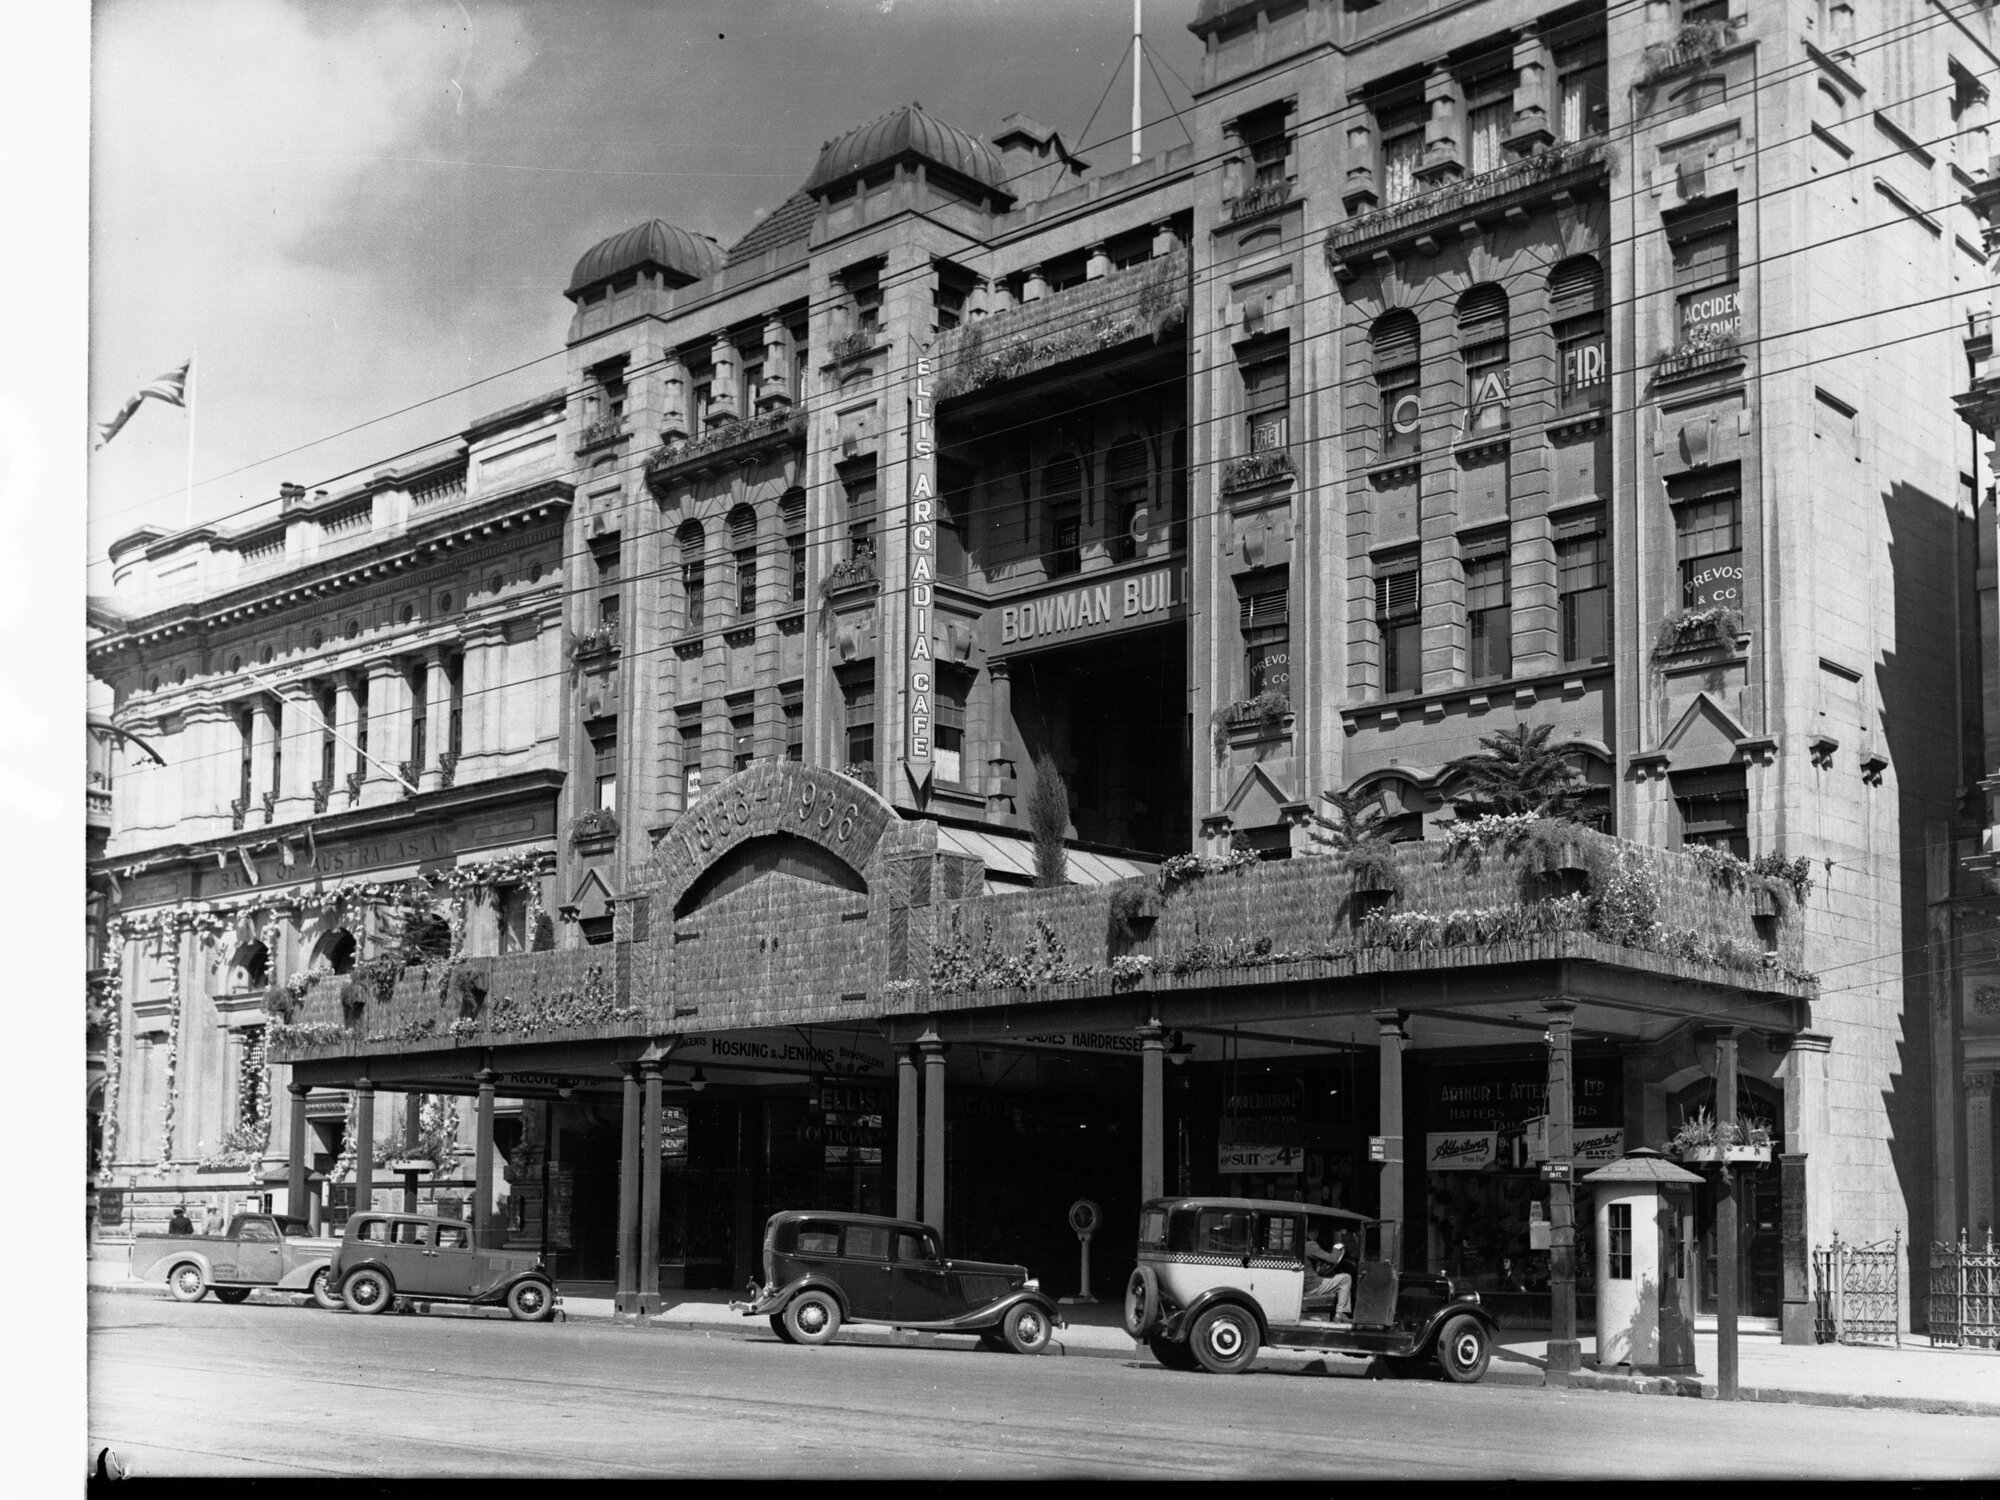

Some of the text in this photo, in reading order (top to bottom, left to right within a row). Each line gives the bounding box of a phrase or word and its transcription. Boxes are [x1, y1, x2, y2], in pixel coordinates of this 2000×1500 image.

[1252, 427, 1276, 447] THE
[911, 357, 933, 757] ELLIS ARCADIA CAFE
[1698, 595, 1706, 605] &
[1001, 584, 1112, 645] BOWMAN
[713, 1038, 769, 1058] HOSKING
[770, 1047, 777, 1058] &
[778, 1044, 834, 1063] JENKINS
[1440, 1085, 1492, 1103] ARTHUR
[1496, 1083, 1505, 1101] L
[1449, 1108, 1505, 1120] HATTERS
[1231, 1154, 1260, 1166] SUIT
